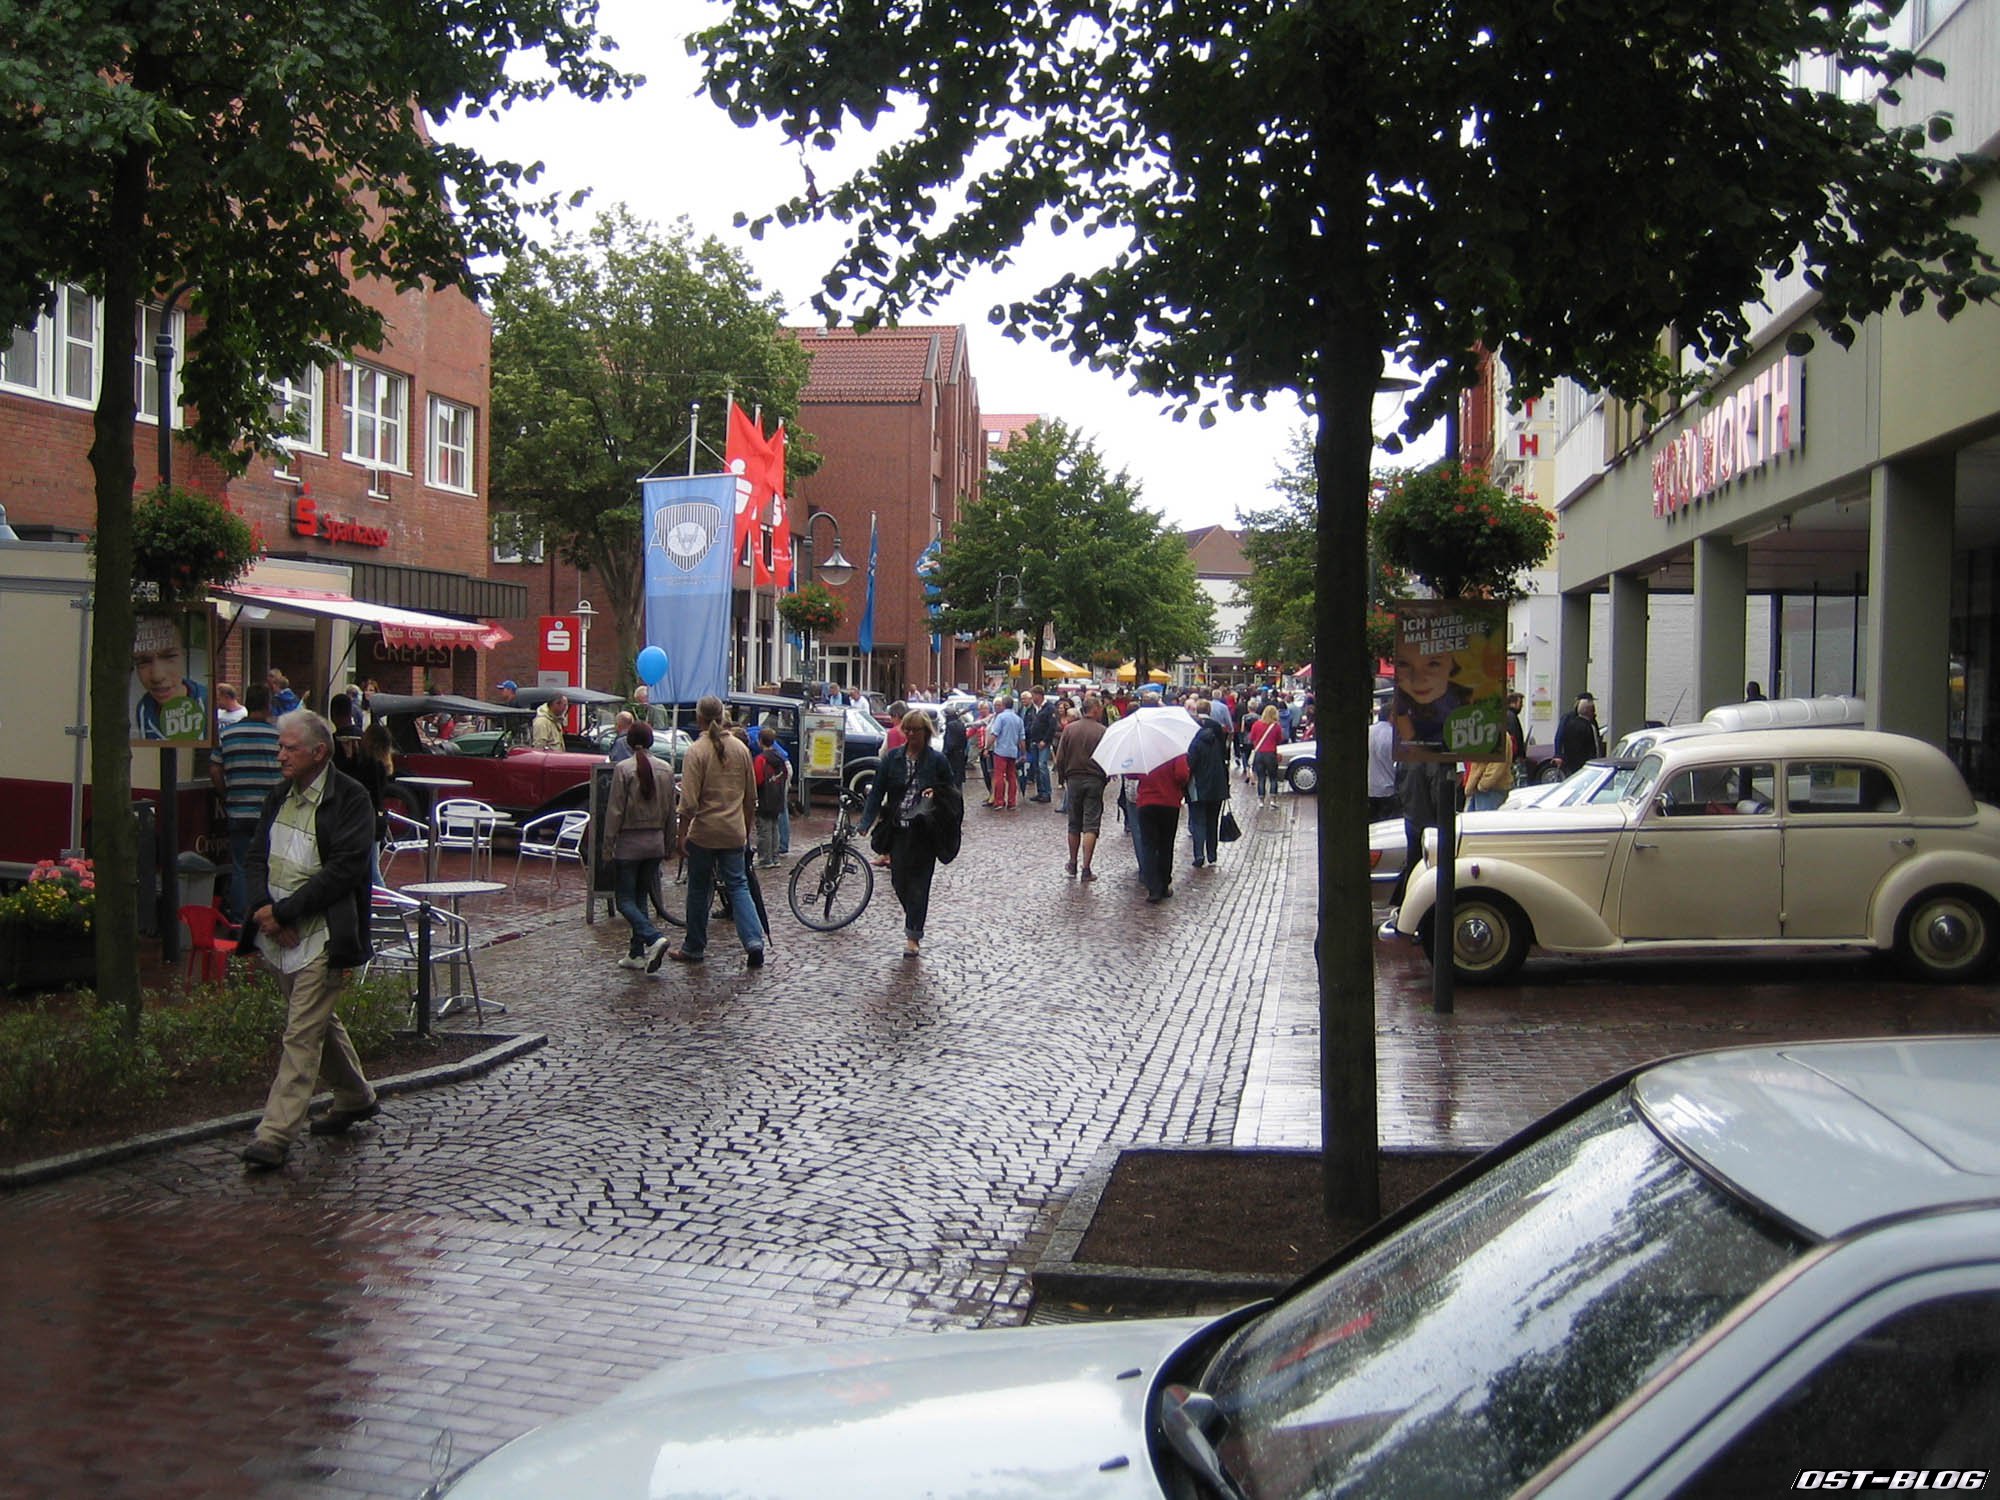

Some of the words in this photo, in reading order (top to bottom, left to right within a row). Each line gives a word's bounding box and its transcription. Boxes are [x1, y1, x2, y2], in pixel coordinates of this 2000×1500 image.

[1652, 355, 1798, 520] WOOLWORTH
[323, 512, 388, 547] Sparkasse
[1403, 618, 1426, 632] ICH
[1405, 631, 1428, 644] MAL
[1420, 637, 1469, 655] RIESE.
[166, 713, 204, 736] DU?
[1452, 723, 1497, 750] DU?
